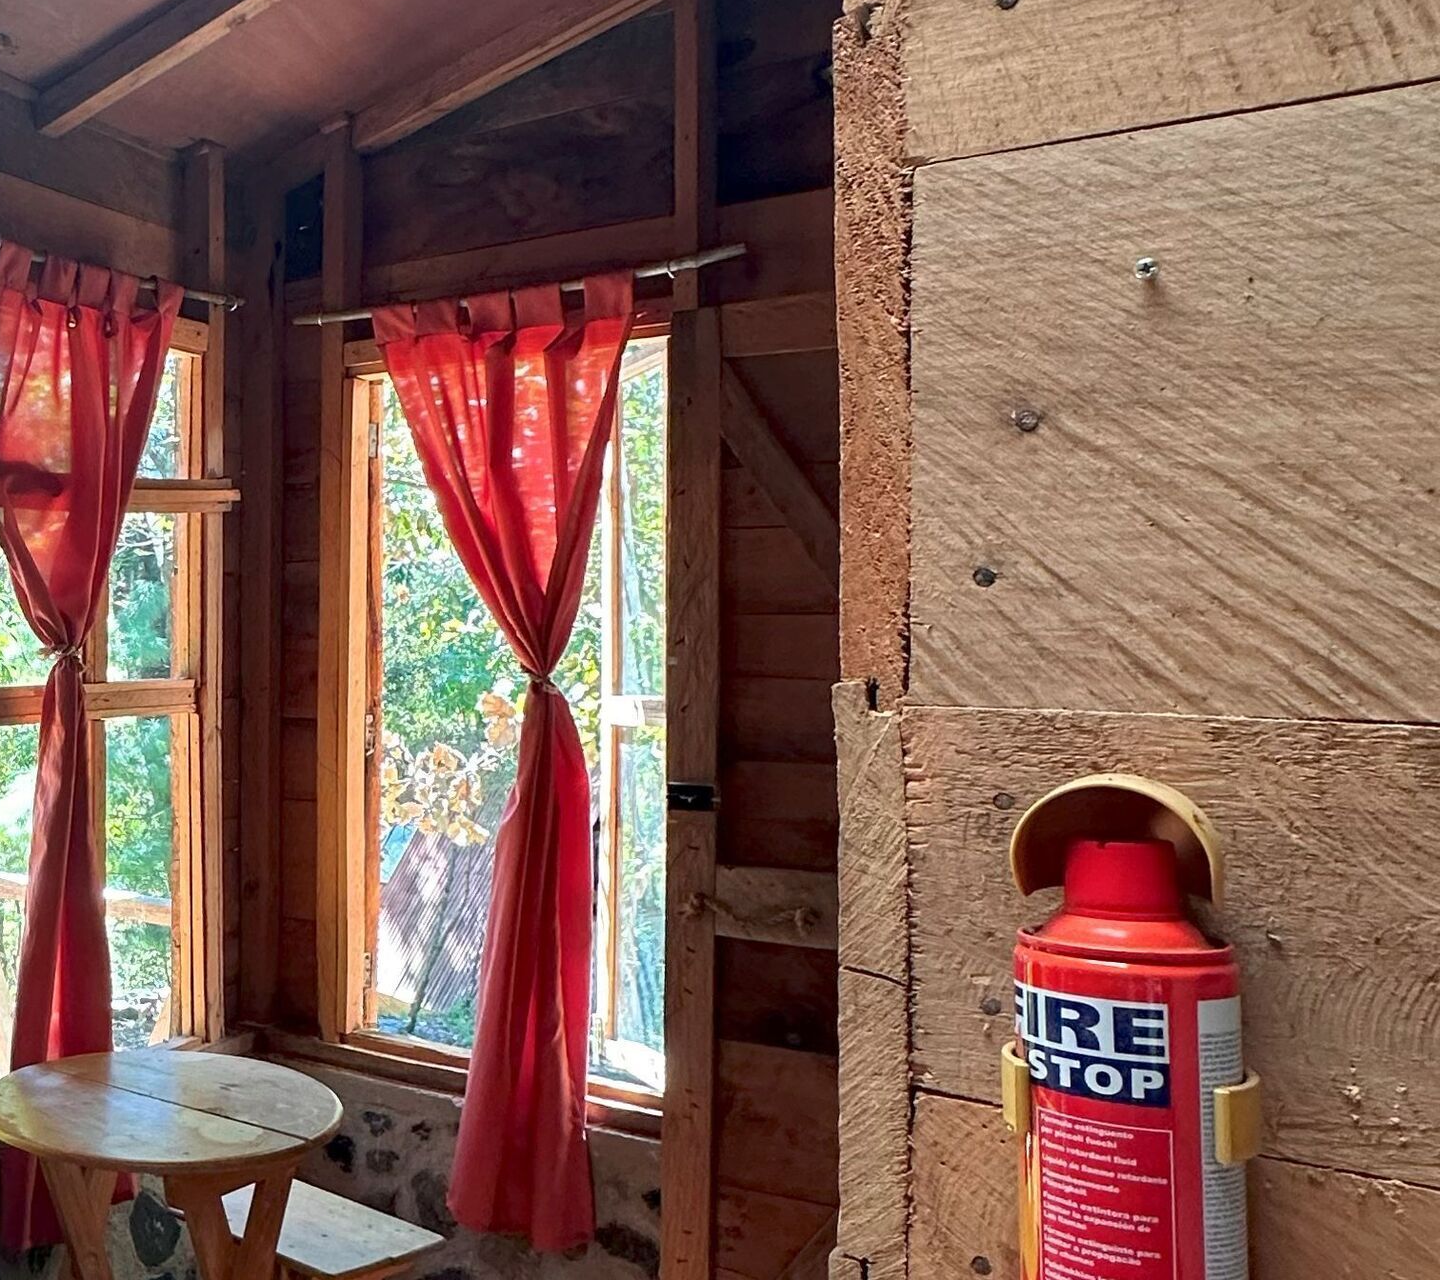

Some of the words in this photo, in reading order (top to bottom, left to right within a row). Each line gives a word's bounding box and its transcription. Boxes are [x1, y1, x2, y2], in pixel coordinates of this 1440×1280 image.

[1029, 1049, 1164, 1099] STOP
[1085, 1136, 1117, 1148] fuochi
[1066, 1146, 1112, 1162] retardant
[1079, 1203, 1130, 1219] extintora
[1132, 1214, 1159, 1222] para
[1137, 1224, 1151, 1232] de
